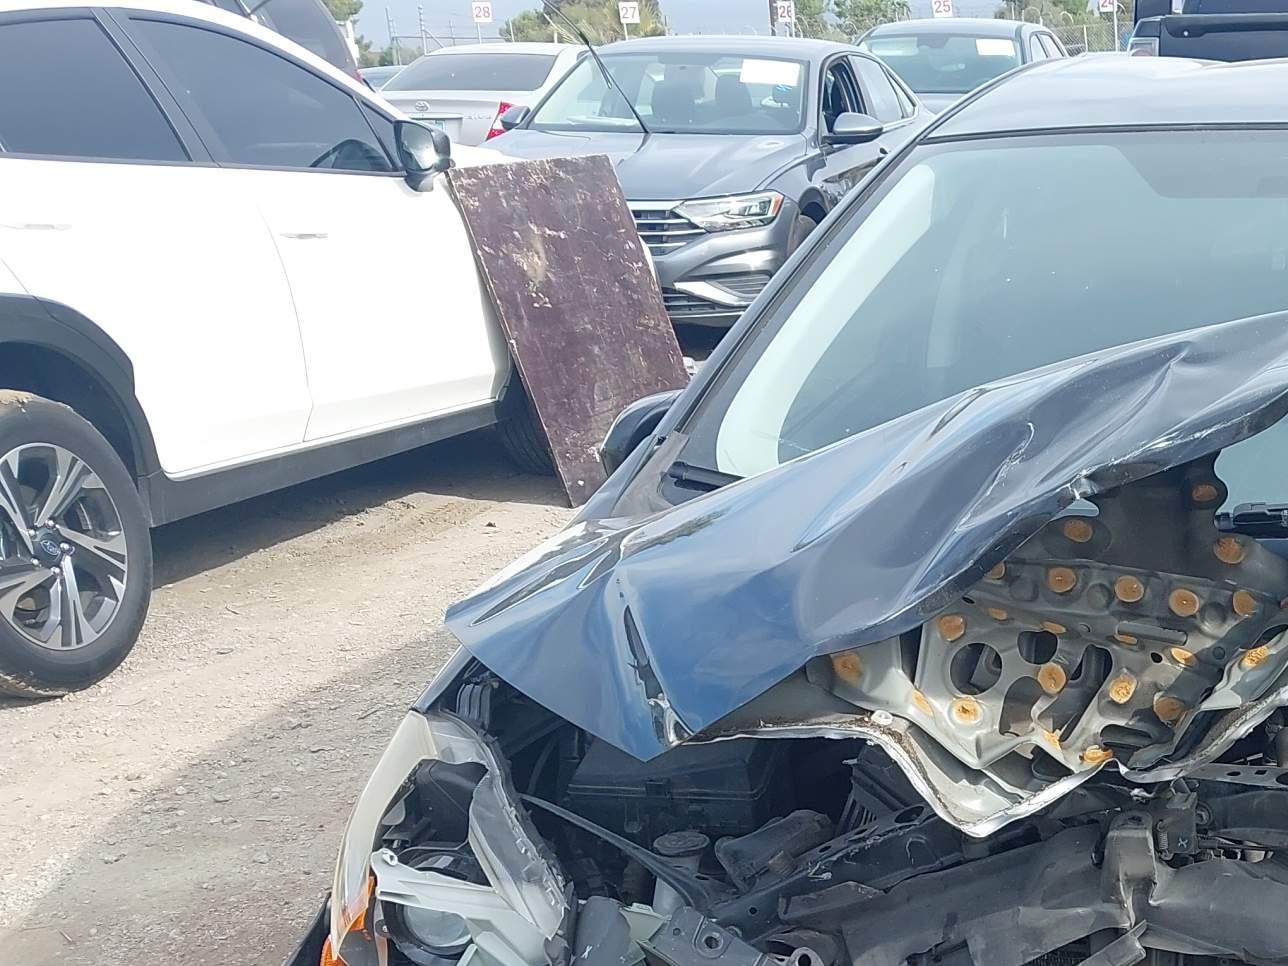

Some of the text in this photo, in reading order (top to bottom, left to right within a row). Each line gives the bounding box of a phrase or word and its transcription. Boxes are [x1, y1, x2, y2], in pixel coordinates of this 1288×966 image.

[474, 6, 491, 18] 28
[934, 0, 951, 13] 25
[621, 7, 637, 19] 27
